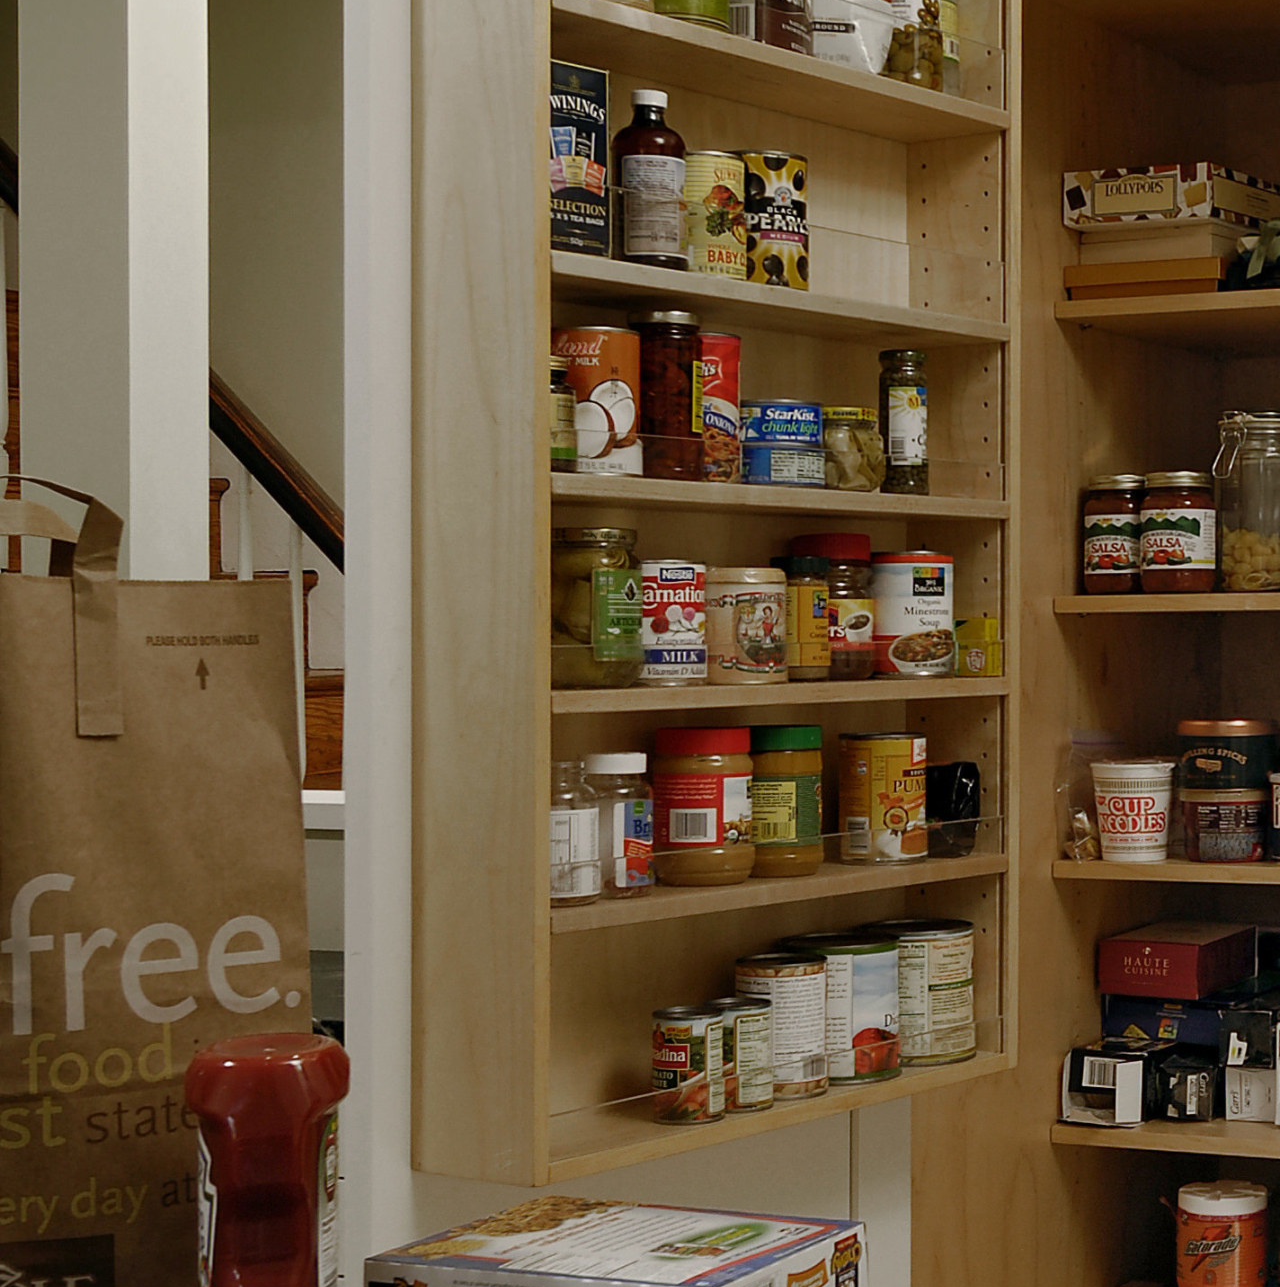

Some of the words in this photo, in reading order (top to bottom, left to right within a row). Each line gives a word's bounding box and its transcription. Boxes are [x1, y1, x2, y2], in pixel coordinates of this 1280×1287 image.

[1105, 181, 1164, 197] LOLLYPOPS
[767, 206, 797, 216] BLACK
[707, 249, 739, 265] BABY
[575, 357, 600, 366] MILK
[764, 407, 818, 422] StarKist
[761, 421, 798, 433] chunk
[800, 422, 818, 434] light
[1091, 543, 1126, 554] SALSA
[1146, 537, 1182, 548] SALSA
[919, 618, 941, 629] Soup
[662, 651, 699, 662] MILK
[1108, 797, 1155, 815] CUP
[1100, 812, 1166, 833] NOODLES
[0, 873, 301, 1035] free.
[1124, 956, 1170, 968] HAUTE
[1124, 967, 1169, 977] CUISINE
[22, 1022, 173, 1095] food
[70, 1176, 149, 1224] day
